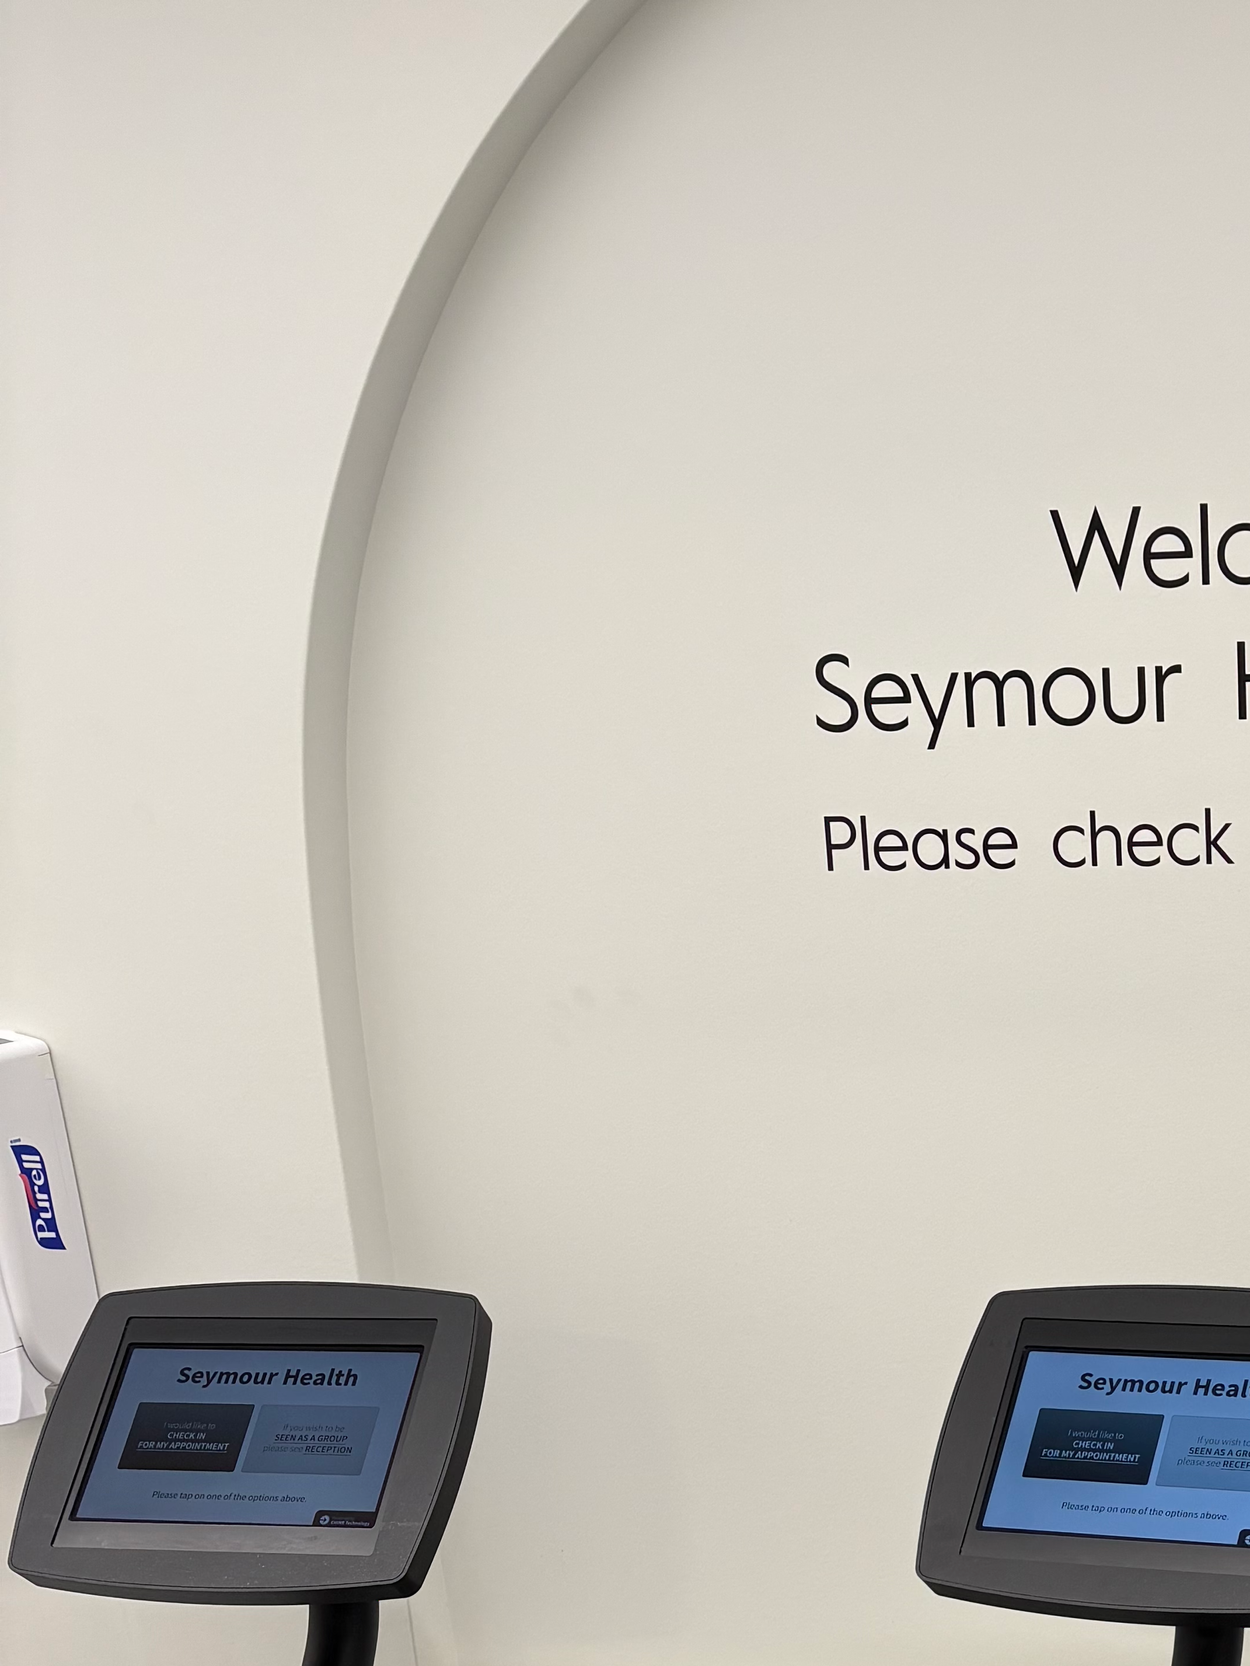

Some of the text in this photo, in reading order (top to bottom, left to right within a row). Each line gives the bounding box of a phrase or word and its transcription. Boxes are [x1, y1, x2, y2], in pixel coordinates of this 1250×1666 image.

[816, 654, 1181, 749] Seymour
[824, 816, 1018, 871] Please
[1053, 808, 1234, 868] check
[20, 1154, 57, 1241] Purell
[177, 1367, 358, 1388] Seymour Health
[1078, 1372, 1187, 1396] Seymour
[297, 1434, 309, 1442] AS
[1072, 1430, 1098, 1438] would
[1099, 1431, 1114, 1439] like
[169, 1442, 229, 1450] APPOINTMENT
[1073, 1440, 1103, 1449] CHECK
[1204, 1438, 1220, 1446] you
[304, 1445, 353, 1453] RECEPTION
[1188, 1447, 1212, 1455] SEEN
[1213, 1448, 1225, 1456] AS
[1042, 1449, 1060, 1457] FOR
[1075, 1451, 1140, 1462] APPOINTMENT
[1177, 1457, 1205, 1466] please
[152, 1491, 178, 1499] Please
[180, 1492, 193, 1501] tap
[223, 1492, 233, 1500] of
[233, 1493, 247, 1501] the
[248, 1494, 279, 1502] options
[280, 1495, 307, 1503] above.
[1061, 1501, 1089, 1511] Please
[1091, 1504, 1106, 1513] tap
[1120, 1507, 1137, 1515] one
[1138, 1507, 1149, 1515] of
[1149, 1508, 1164, 1516] the
[1165, 1510, 1198, 1519] options
[1200, 1511, 1229, 1521] above.
